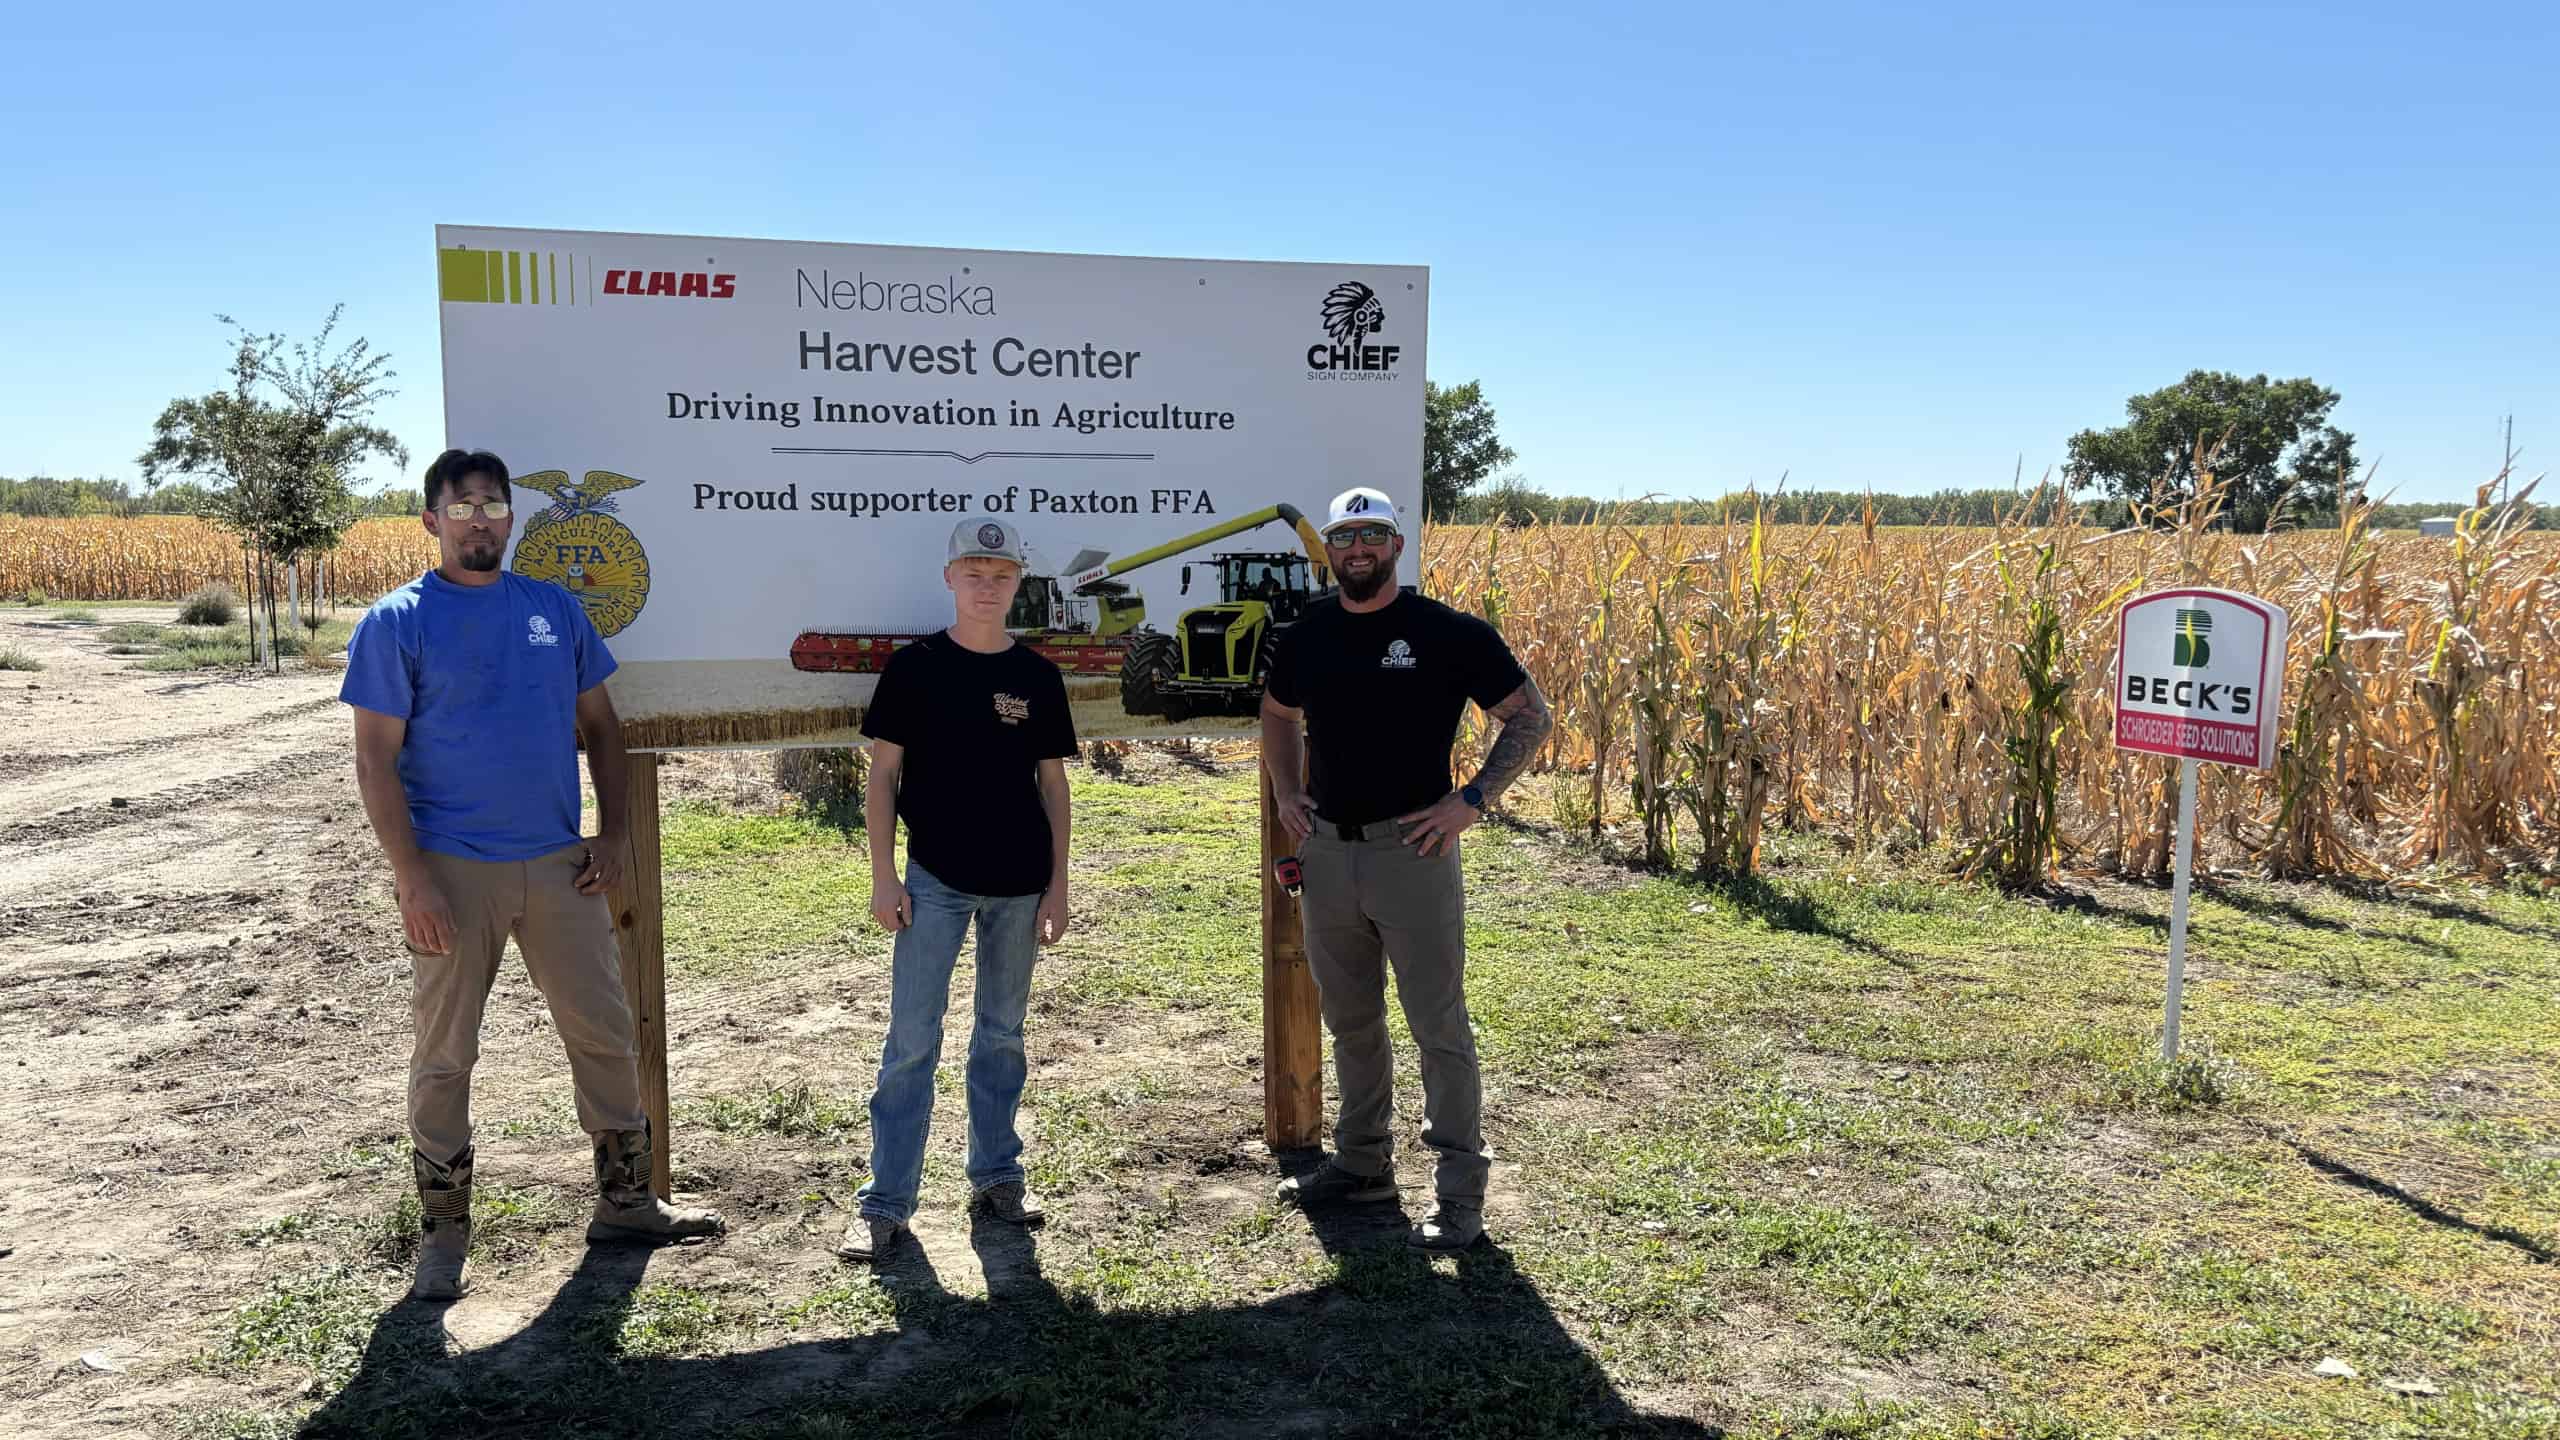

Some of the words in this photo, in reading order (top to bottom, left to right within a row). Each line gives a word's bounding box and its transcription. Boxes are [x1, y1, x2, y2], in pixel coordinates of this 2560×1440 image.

[603, 269, 737, 299] CLAAS
[796, 267, 997, 316] Nebraska
[799, 330, 978, 376] Harvest
[992, 336, 1141, 380] Center
[1307, 344, 1400, 370] CHIEF
[1307, 371, 1336, 381] SIGN
[1340, 371, 1400, 382] COMPANY
[666, 391, 801, 428] Driving
[812, 395, 998, 427] Innovation
[1009, 399, 1041, 427] in
[1052, 401, 1235, 435] Agriculture
[692, 482, 799, 511] Proud
[810, 487, 973, 518] supporter
[983, 485, 1019, 513] of
[1028, 488, 1139, 514] Paxton
[1150, 488, 1217, 515] FFA
[533, 527, 626, 568] AGRICULTURAL
[555, 544, 609, 565] FFA
[528, 634, 559, 644] CHIEF
[1381, 657, 1417, 666] CHIEF
[2127, 674, 2252, 715] BECK'S
[2120, 716, 2174, 746] SCHROEDER
[2175, 723, 2199, 749] SEED
[2200, 726, 2256, 758] SOLUTIONS
